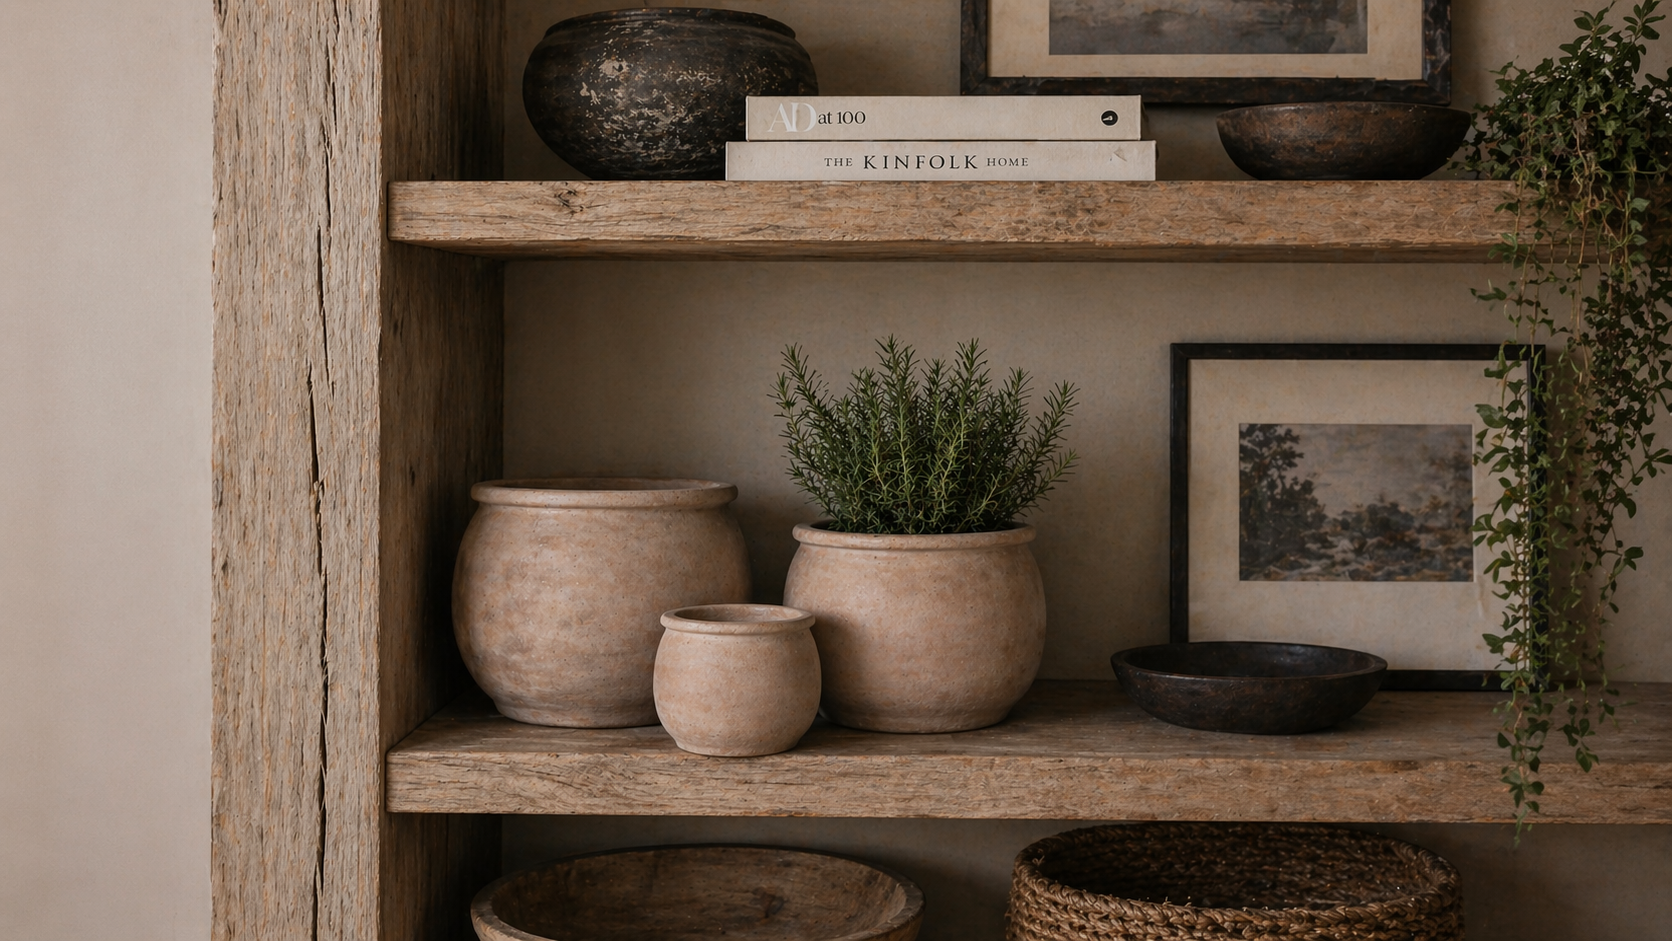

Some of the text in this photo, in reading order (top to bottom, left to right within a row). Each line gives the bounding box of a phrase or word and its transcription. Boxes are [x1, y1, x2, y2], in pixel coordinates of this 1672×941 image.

[767, 102, 866, 133] AD at 100
[824, 155, 1029, 170] THE KINFOLK HOME
